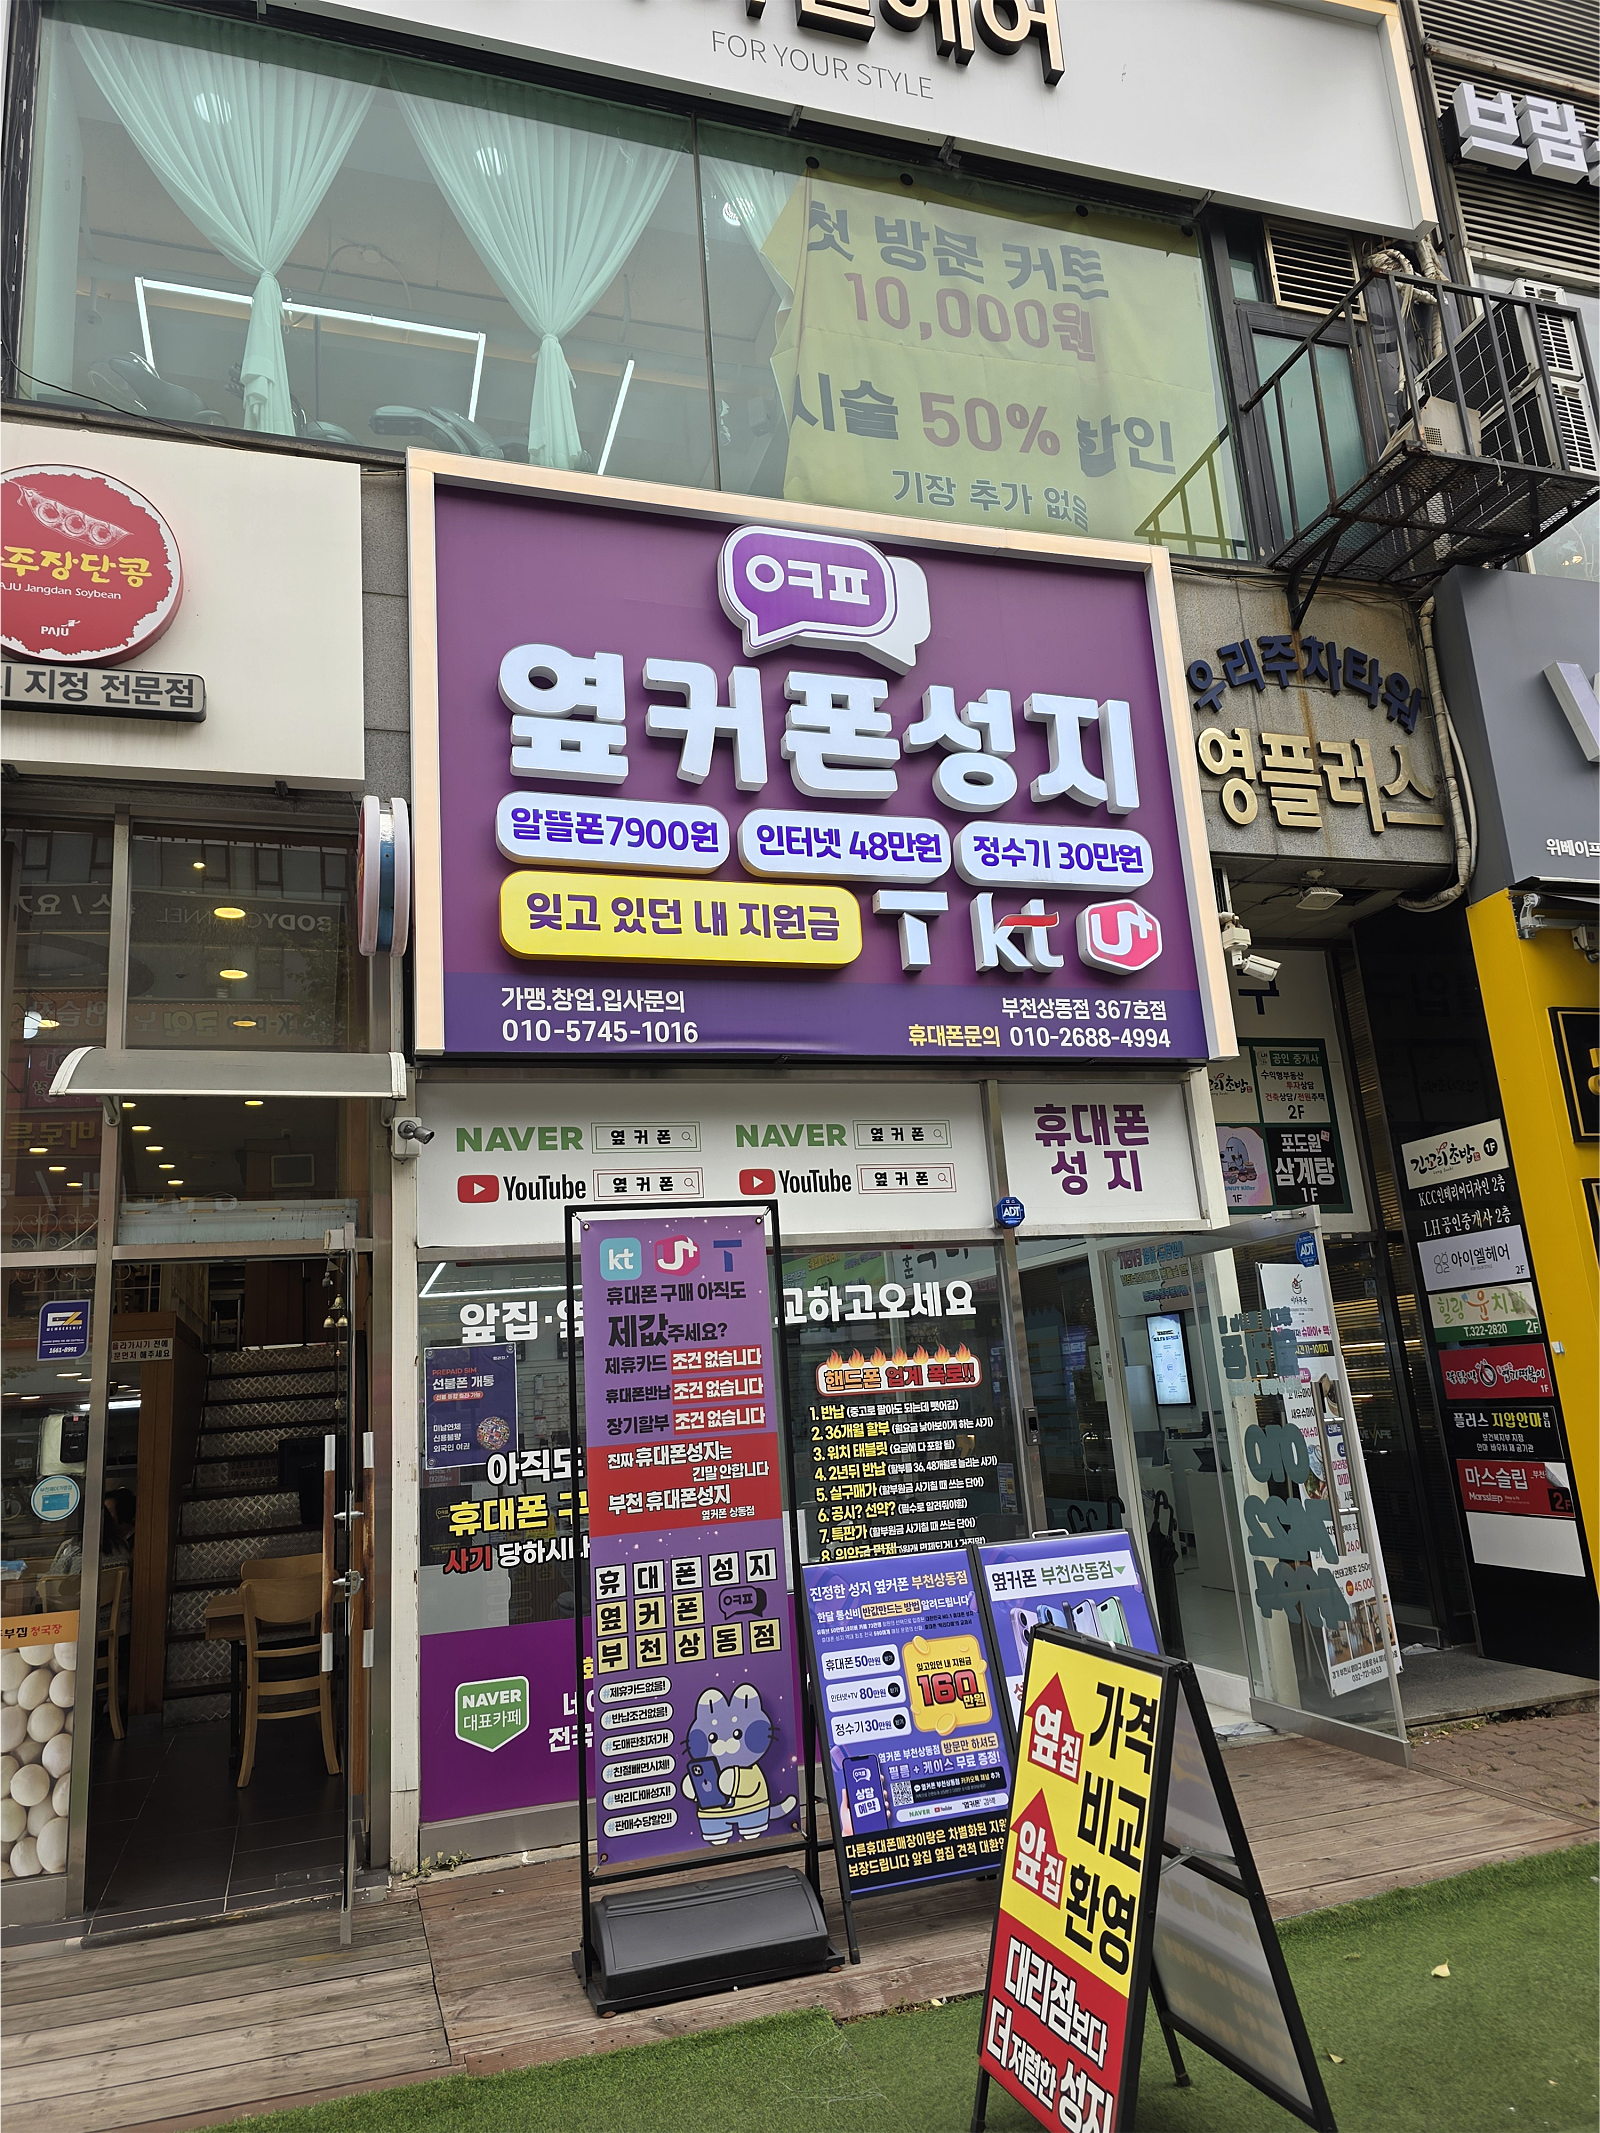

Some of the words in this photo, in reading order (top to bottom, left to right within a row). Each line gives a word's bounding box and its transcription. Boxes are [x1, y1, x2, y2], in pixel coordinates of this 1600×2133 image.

[711, 30, 767, 62] FOR
[773, 49, 849, 82] YOUR
[856, 64, 934, 100] STYLE
[1453, 82, 1600, 186] 브람
[807, 201, 855, 262] 첫
[875, 215, 985, 285] 방문
[1001, 242, 1109, 299] 커트
[844, 272, 1096, 362] 10,000원
[919, 391, 1061, 457] 50%
[892, 470, 957, 508] 기장
[970, 479, 1033, 516] 추가
[0, 545, 152, 588] 주장단콩
[24, 583, 72, 597] Jangdan
[75, 587, 121, 600] Soybean
[24, 669, 89, 703] 지정
[100, 674, 195, 709] 전문점
[498, 643, 1140, 814] 옆커폰성지
[1197, 726, 1445, 833] 영플러스
[510, 807, 720, 855] 알뜰폰7900원
[757, 825, 842, 861] 인터넷
[848, 829, 943, 865] 48만원
[972, 834, 1052, 871] 정수기
[1057, 847, 1145, 875] 30만원
[526, 892, 598, 932] 잊고
[610, 896, 683, 937] 있던
[693, 898, 730, 939] 내
[738, 901, 840, 943] 지원금
[969, 891, 1066, 973] kt
[1001, 994, 1091, 1021] 부천상동점
[1095, 997, 1168, 1023] 367호점
[501, 1019, 699, 1046] 010-5745-1016
[907, 1023, 1001, 1049] 휴대폰문의
[1009, 1026, 1172, 1049] 010-2688-4994
[1293, 1053, 1320, 1066] 중개사
[1286, 1081, 1315, 1091] 투자상담
[1033, 1102, 1151, 1148] 휴대폰
[1287, 1104, 1305, 1120] 2F
[456, 1125, 585, 1153] NAVER
[735, 1123, 848, 1148] NAVER
[1280, 1133, 1323, 1154] 포도원
[778, 1168, 852, 1194] YouTube
[1274, 1156, 1336, 1187] 삼계탕
[502, 1173, 587, 1202] YouTube
[1301, 1187, 1319, 1203] 1F
[1417, 1178, 1491, 1208] KCC인테리어디자인
[1491, 1173, 1506, 1193] 2층
[1002, 1206, 1020, 1217] ADT
[1494, 1205, 1512, 1225] 2층
[608, 1248, 635, 1271] kt
[1300, 1242, 1314, 1257] ADT
[1451, 1242, 1511, 1269] 아이엘헤어
[606, 1285, 659, 1306] 휴대폰
[660, 1282, 694, 1302] 구매
[697, 1280, 747, 1301] 아직도
[153, 1339, 169, 1349] 전에
[1463, 1324, 1508, 1337] T.322-2820
[140, 1349, 170, 1360] 해주세요
[604, 1354, 668, 1375] 제휴카드
[671, 1350, 703, 1371] 조건
[703, 1347, 762, 1369] 없습니다
[605, 1384, 671, 1404] 휴대폰반납
[673, 1381, 704, 1400] 조건
[705, 1377, 764, 1398] 없습니다
[823, 1367, 882, 1392] 핸드폰
[885, 1365, 923, 1388] 업계
[926, 1362, 976, 1385] 폭로!!
[606, 1414, 670, 1436] 장기할부
[674, 1410, 705, 1431] 조건
[706, 1406, 766, 1428] 없습니다
[820, 1404, 845, 1420] 반납
[1453, 1412, 1489, 1429] 플러스
[1491, 1411, 1542, 1429] 지압안마
[825, 1422, 866, 1440] 36개월
[865, 1421, 891, 1437] 할부
[607, 1452, 634, 1470] 진짜
[635, 1440, 733, 1468] 휴대폰성지는
[826, 1443, 851, 1461] 워치
[853, 1440, 889, 1459] 태블릿
[692, 1466, 718, 1483] 긴말
[719, 1460, 769, 1479] 안합니다
[862, 1460, 886, 1478] 반납
[1464, 1466, 1529, 1490] 마스슬립
[608, 1492, 644, 1516] 부천
[645, 1483, 731, 1512] 휴대폰성지
[829, 1482, 878, 1502] 실구매가
[448, 1492, 548, 1537] 휴대폰
[701, 1509, 728, 1522] 옆커폰
[729, 1505, 756, 1519] 상동점
[831, 1503, 863, 1522] 공시?
[865, 1500, 896, 1518] 선약?
[831, 1523, 869, 1542] 특판가
[443, 1544, 492, 1575] 사기
[809, 1584, 847, 1603] 진정한
[848, 1580, 872, 1598] 성지
[874, 1576, 910, 1595] 옆커폰
[911, 1569, 969, 1590] 부천상동점
[991, 1567, 1038, 1592] 옆커폰
[1040, 1560, 1115, 1586] 부천상동점
[816, 1610, 834, 1625] 한달
[836, 1606, 862, 1621] 통신비
[862, 1602, 903, 1618] 반값만드는
[921, 1595, 970, 1612] 알려드립니다
[29, 1622, 63, 1637] 청국장
[825, 1656, 854, 1673] 휴대폰
[854, 1654, 882, 1669] 50만원
[952, 1655, 973, 1669] 지원금
[462, 1688, 522, 1709] NAVER
[463, 1708, 522, 1732] 대표카페
[834, 1720, 865, 1738] 정수기
[1088, 1680, 1158, 1776] 가격
[877, 1752, 902, 1764] 옆커폰
[902, 1744, 941, 1760] 부천상동점
[942, 1739, 970, 1754] 방문만
[971, 1735, 998, 1750] 하셔도
[888, 1762, 911, 1780] 필름
[922, 1758, 955, 1775] 케이스
[956, 1755, 977, 1769] 무료
[855, 1786, 875, 1801] 상담
[1076, 1769, 1147, 1875] 비교
[845, 1828, 946, 1860] 다른휴대폰매장이랑은
[947, 1820, 988, 1842] 차별화된
[848, 1851, 911, 1878] 보장드립니다
[911, 1850, 933, 1866] 앞집
[933, 1846, 955, 1862] 옆집
[957, 1842, 978, 1859] 견적
[1064, 1861, 1138, 1977] 환영
[1002, 1935, 1110, 2069] 대리점보다
[986, 1998, 1014, 2070] 더
[1007, 2030, 1058, 2110] 저렴한
